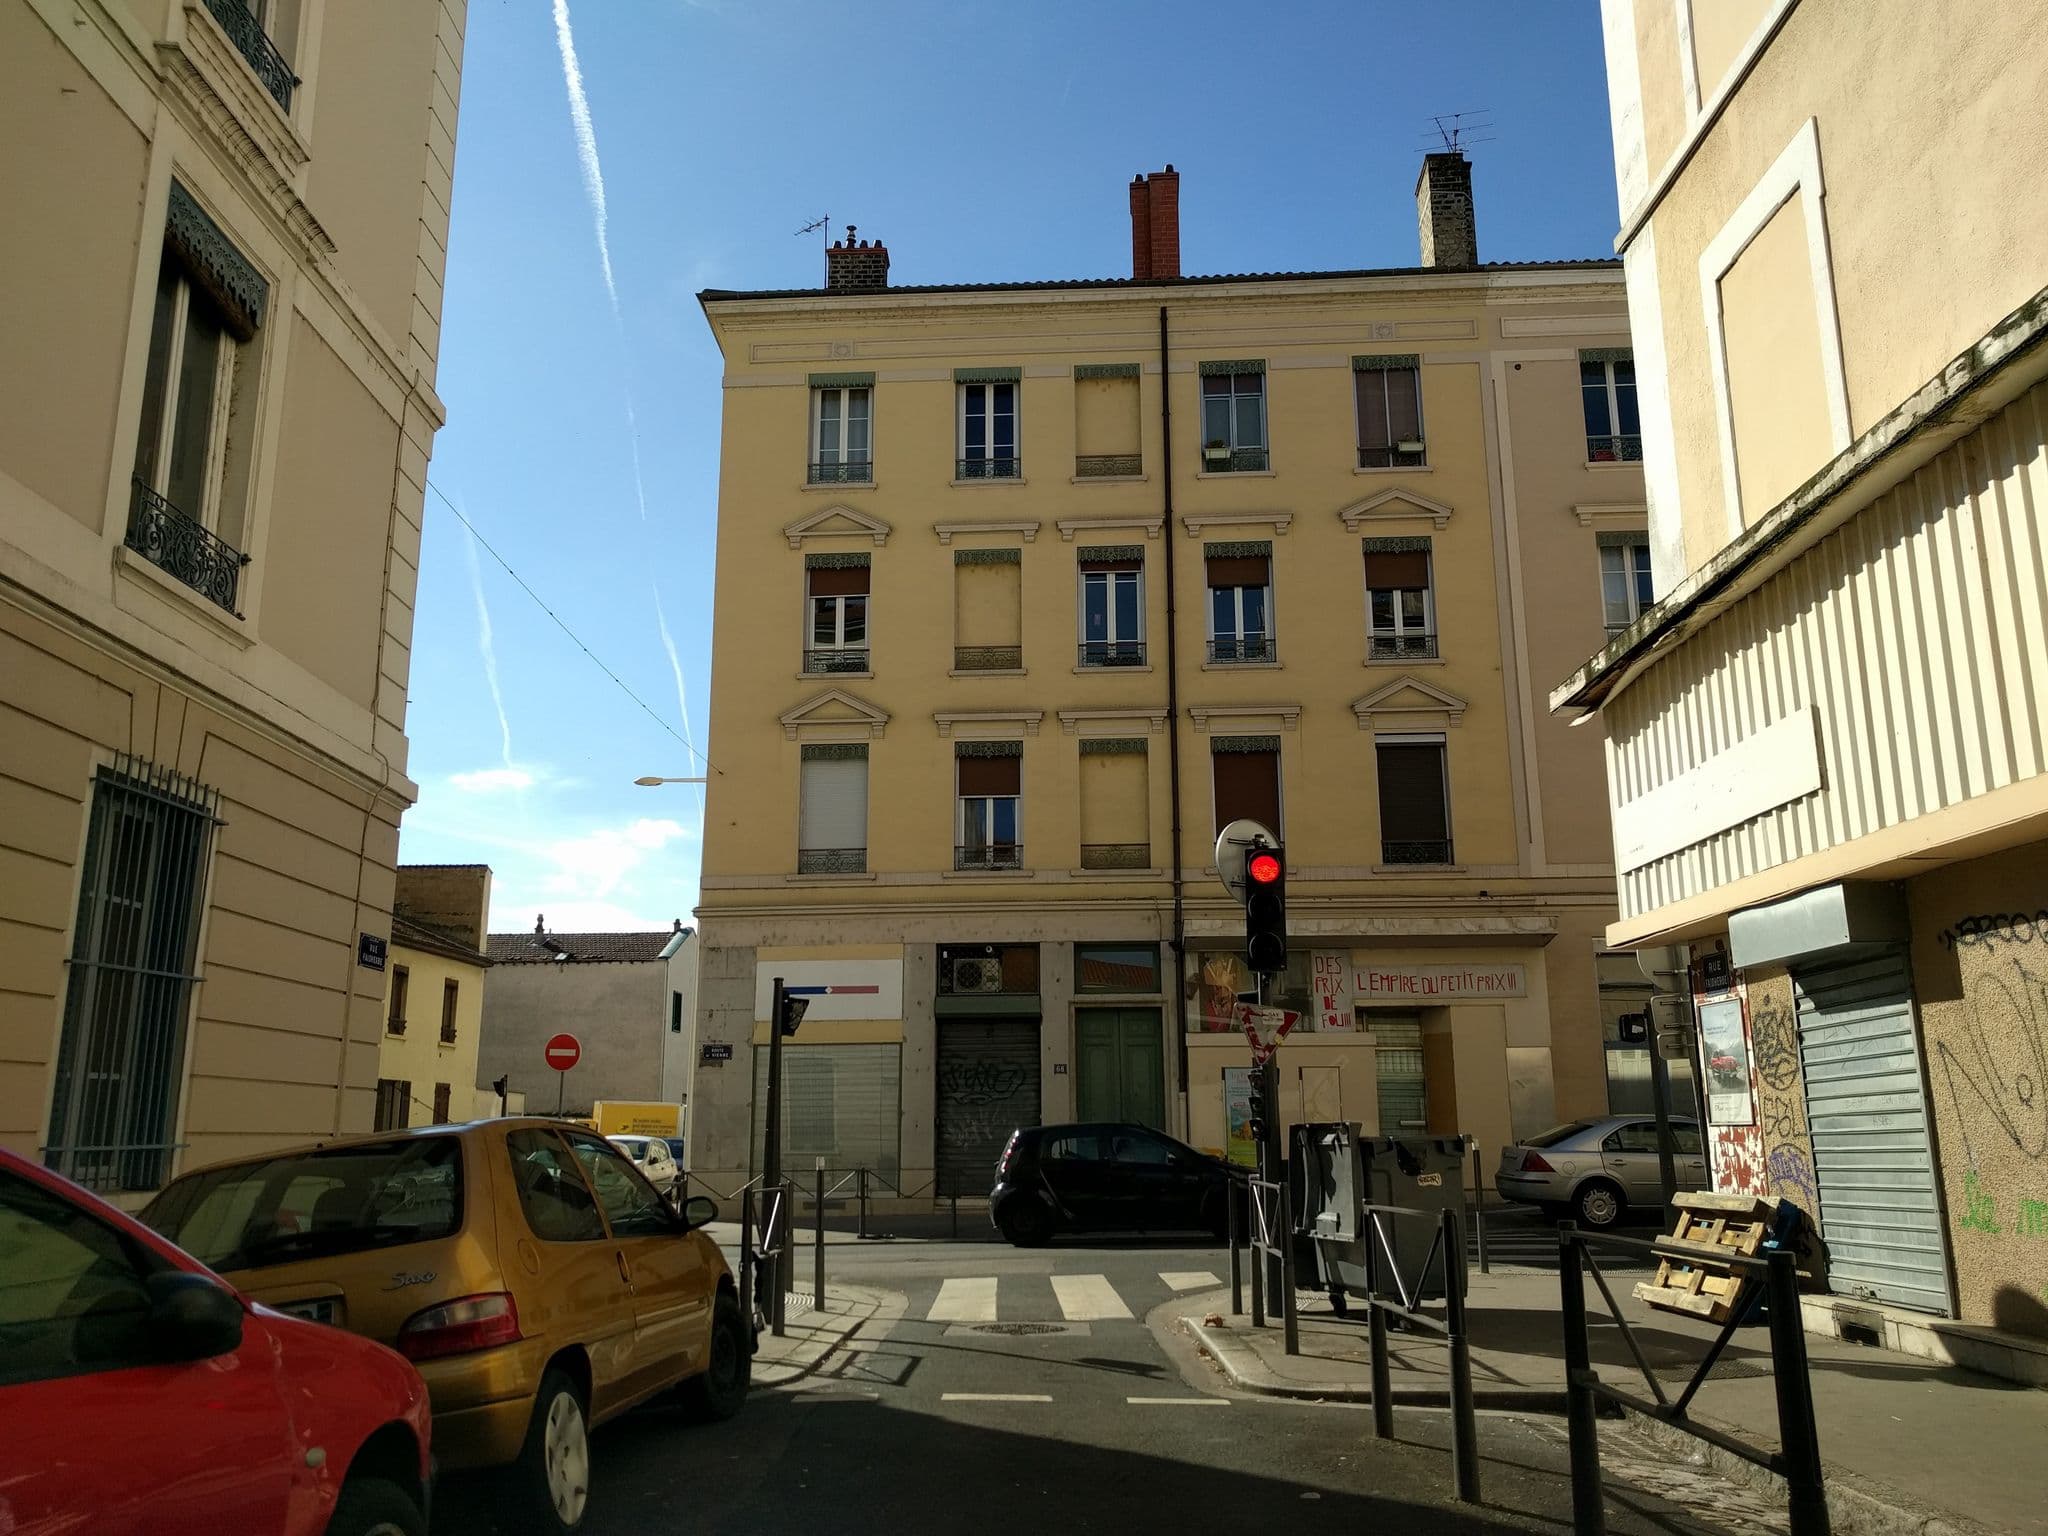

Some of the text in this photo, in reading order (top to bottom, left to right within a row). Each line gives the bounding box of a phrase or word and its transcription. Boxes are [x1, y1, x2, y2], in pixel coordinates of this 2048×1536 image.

[1315, 956, 1342, 975] DES
[1708, 960, 1722, 972] RUE
[1314, 975, 1345, 994] PRIX
[1421, 977, 1438, 995] DU
[1440, 971, 1473, 992] PETIT
[1323, 994, 1337, 1010] DE
